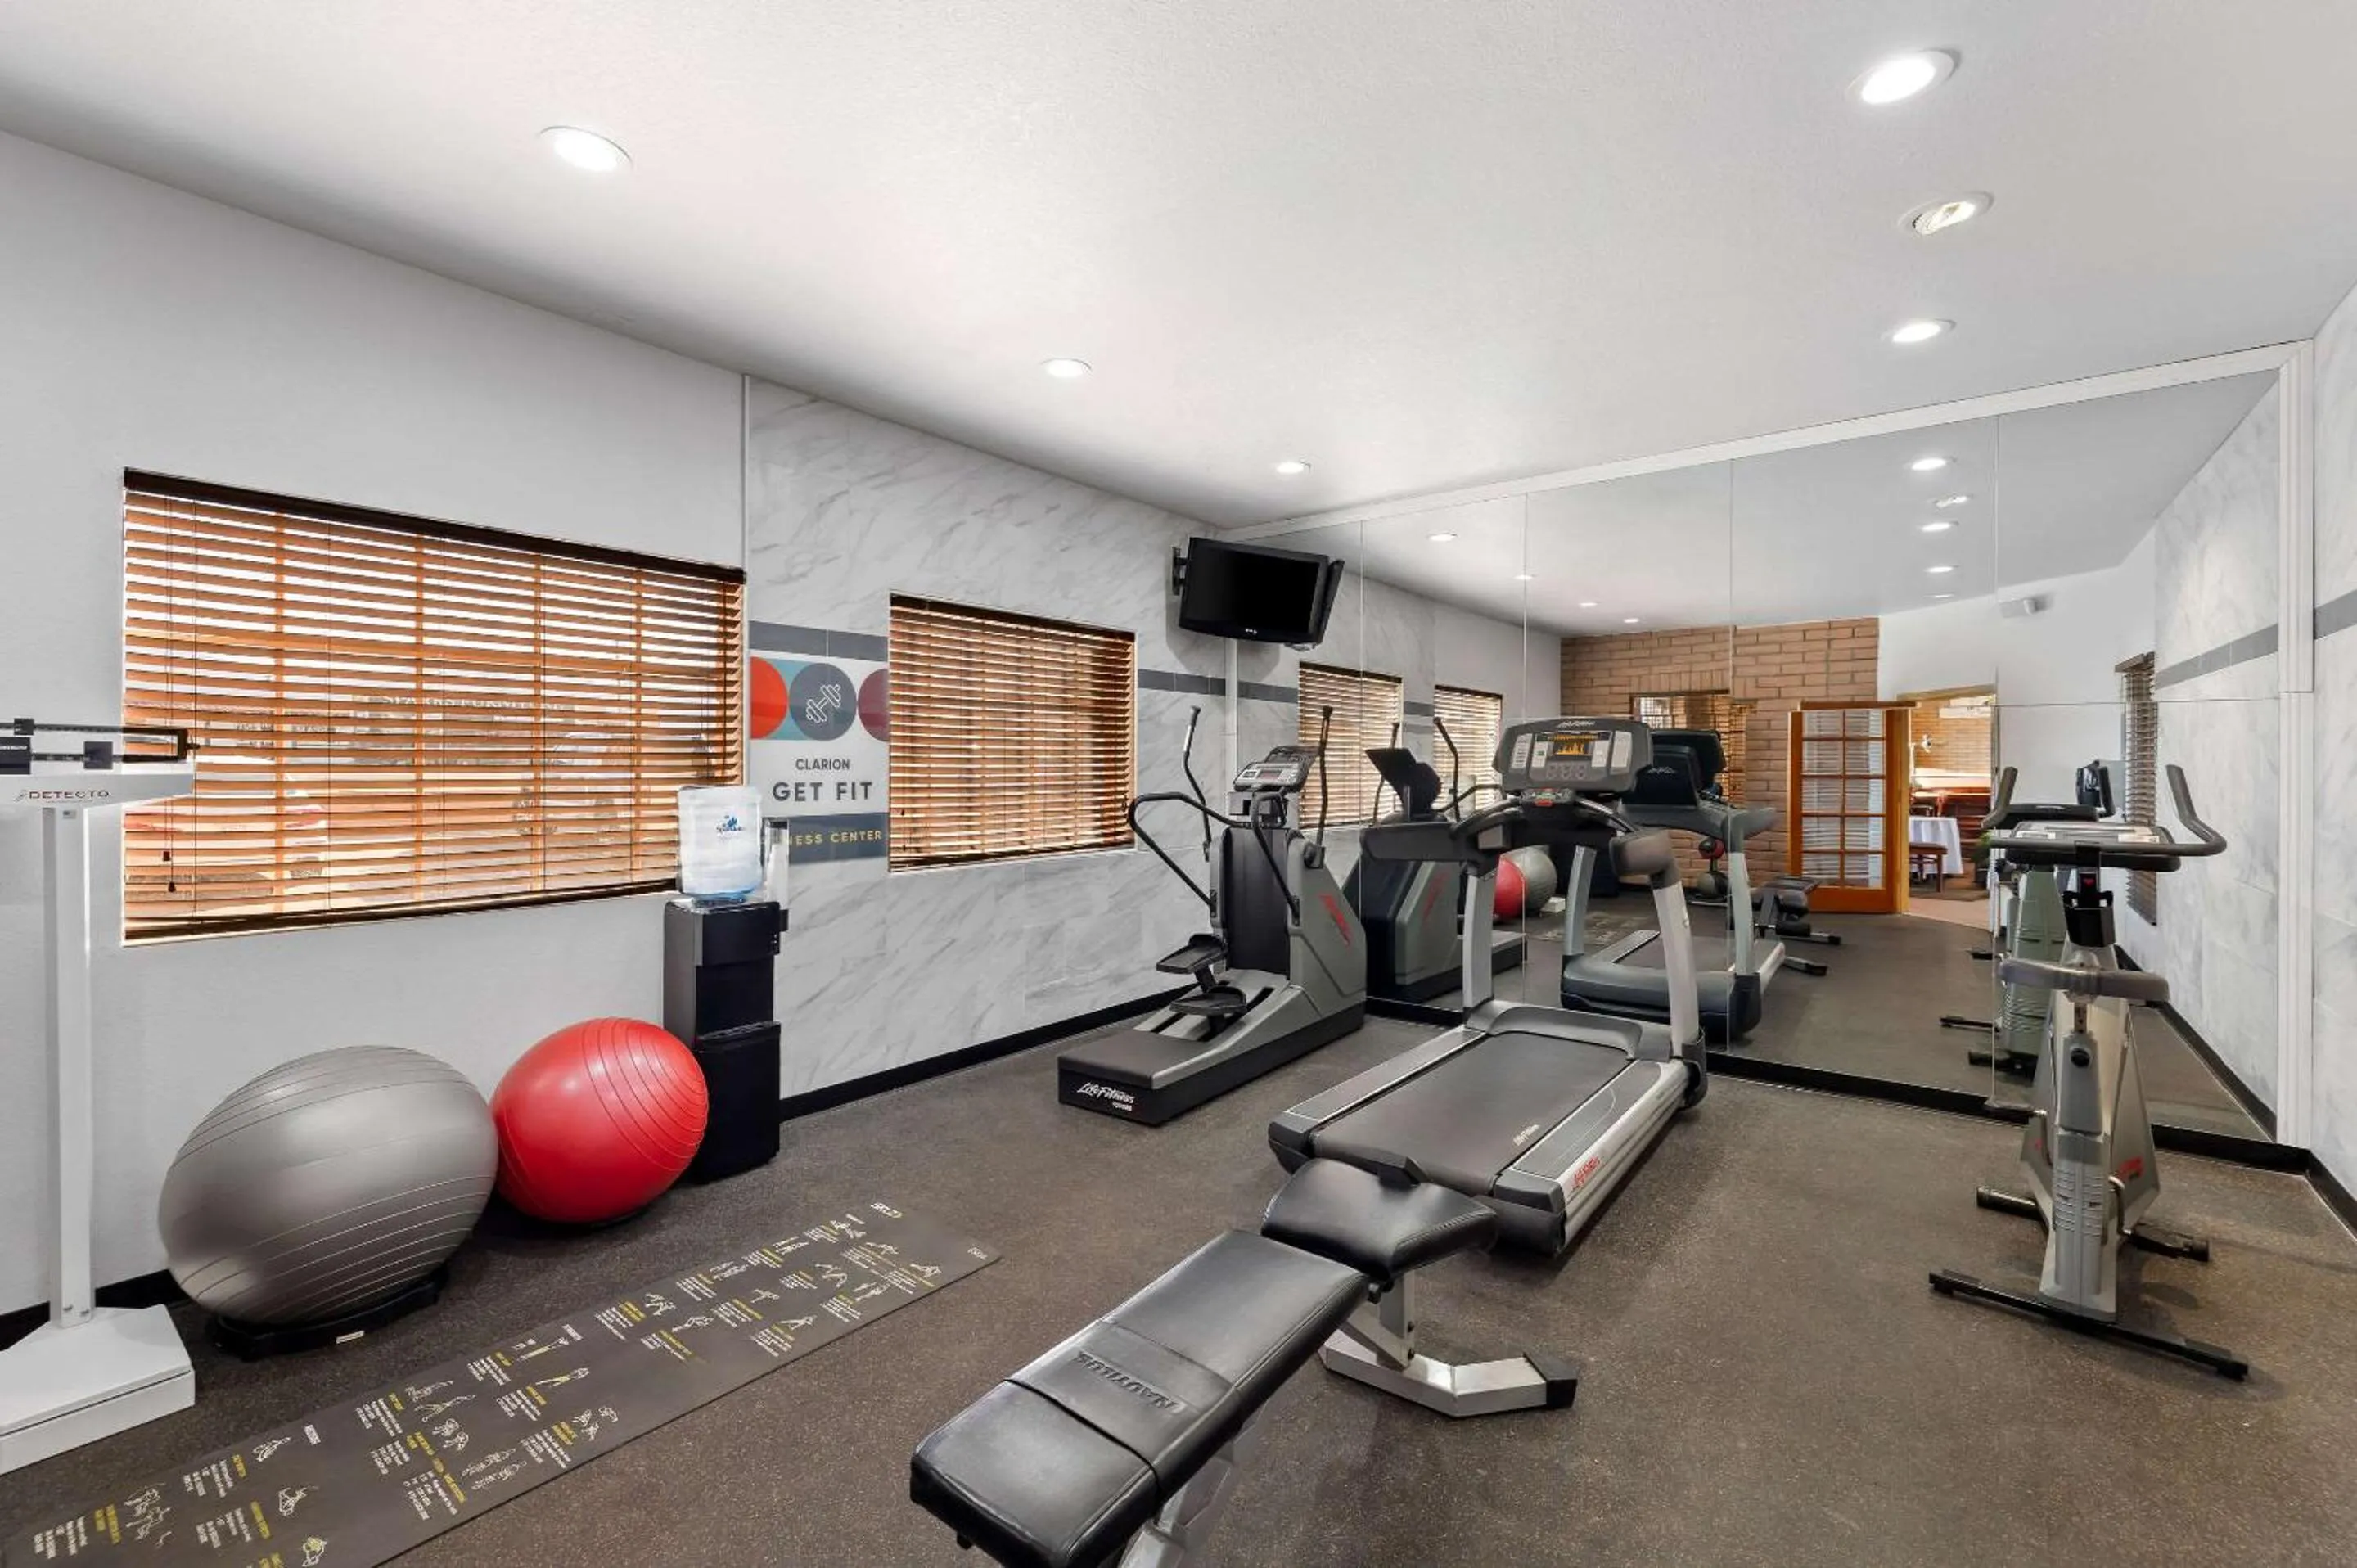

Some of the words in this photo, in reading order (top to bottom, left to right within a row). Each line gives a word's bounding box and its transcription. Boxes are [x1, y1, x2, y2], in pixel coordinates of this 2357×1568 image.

[795, 758, 850, 770] CLARION
[29, 790, 110, 800] DETECTO
[773, 782, 823, 802] GET
[836, 782, 873, 800] FIT
[830, 830, 882, 845] CENTER
